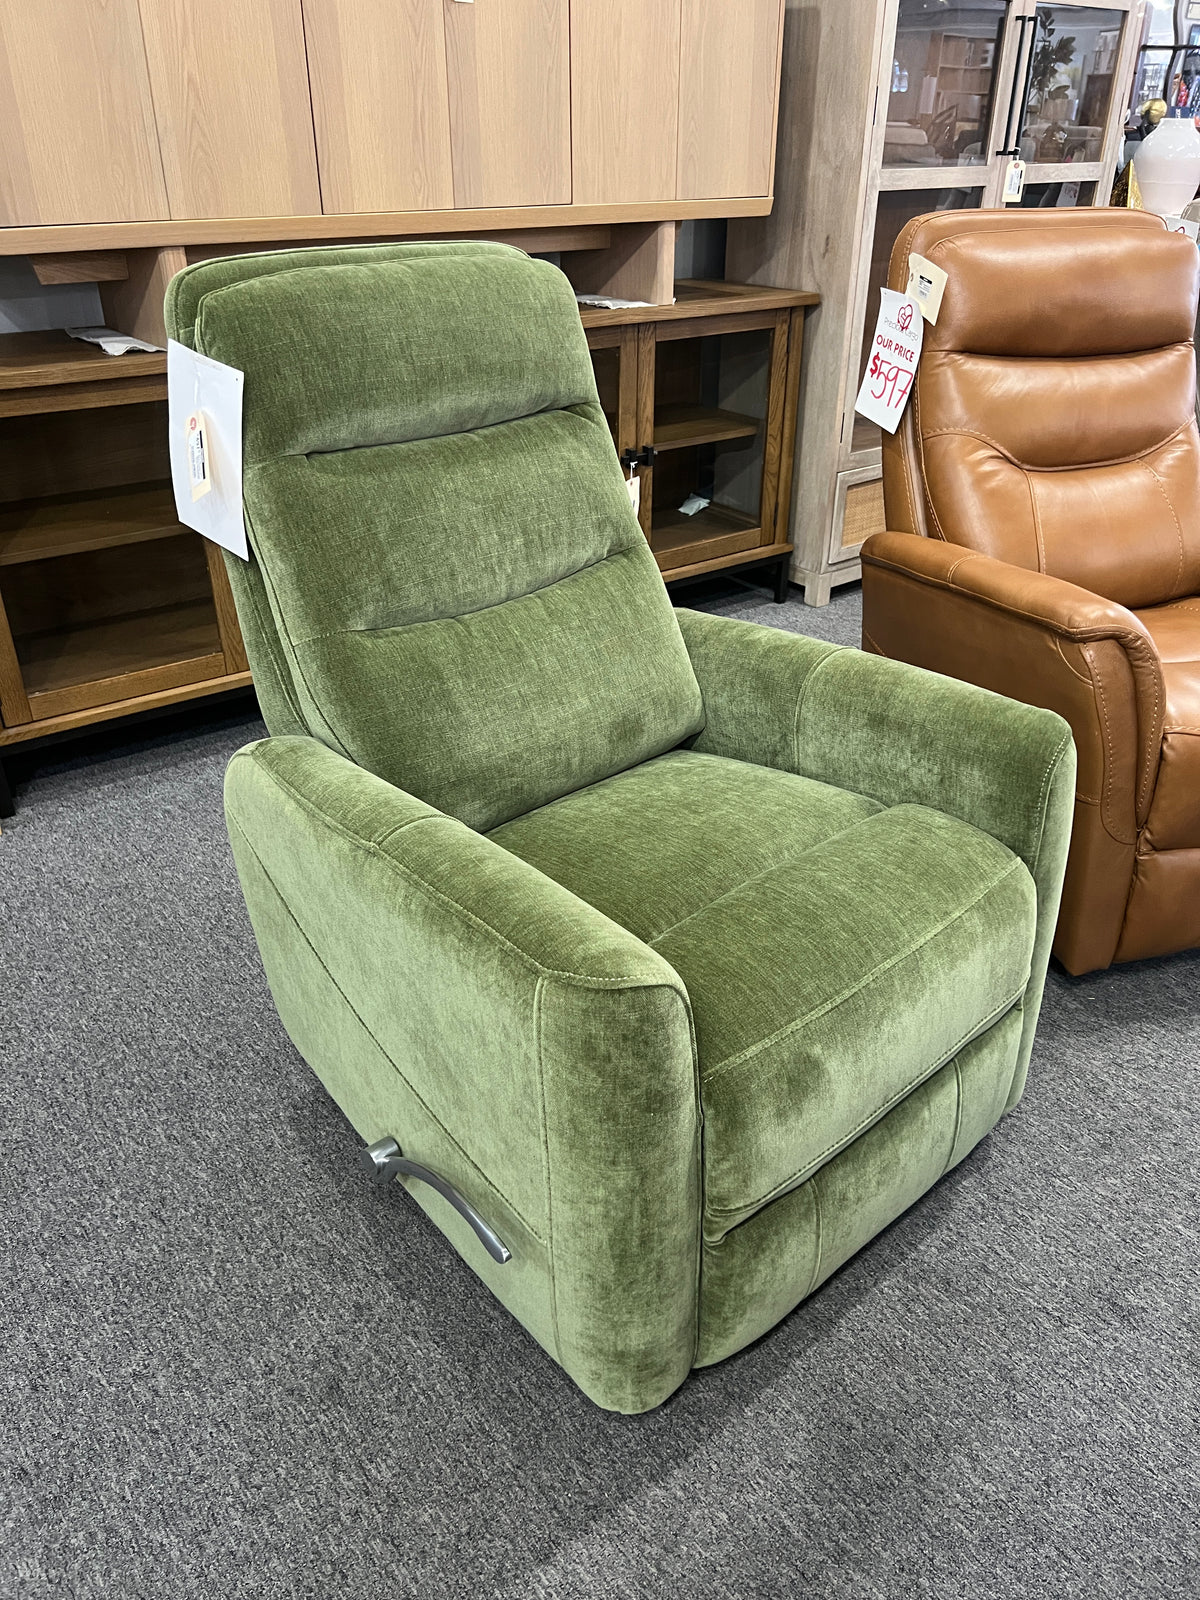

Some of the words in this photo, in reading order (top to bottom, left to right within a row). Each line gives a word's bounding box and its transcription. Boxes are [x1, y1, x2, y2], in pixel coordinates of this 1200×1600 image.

[876, 334, 893, 351] OUR
[893, 343, 915, 363] PRICE
[869, 352, 914, 409] $597
